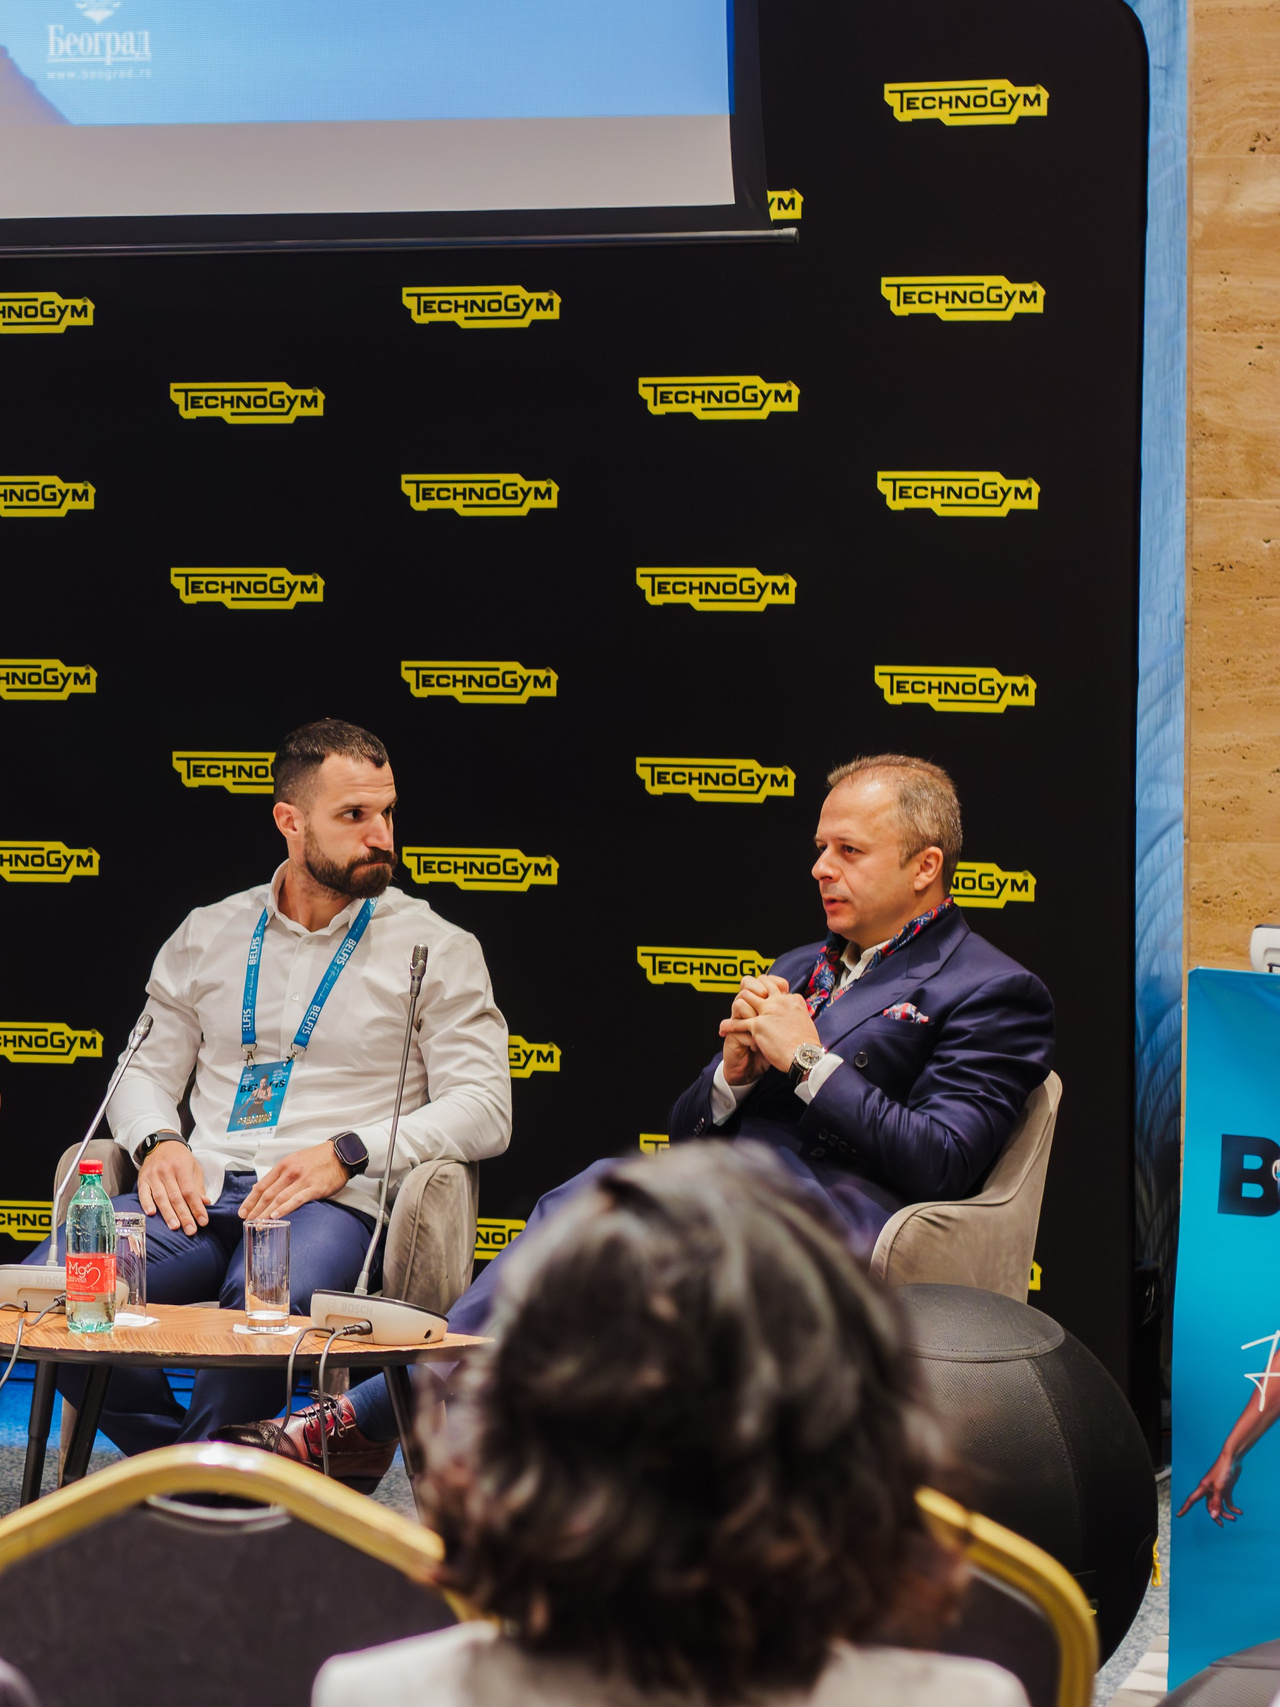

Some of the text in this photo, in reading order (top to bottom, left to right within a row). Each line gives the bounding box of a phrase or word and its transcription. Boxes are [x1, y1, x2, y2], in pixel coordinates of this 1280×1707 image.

[46, 24, 151, 65] Београд
[176, 757, 274, 786] TECHNO
[248, 936, 261, 966] BELFIS
[336, 937, 358, 966] BELFIS
[641, 952, 770, 984] TECHNOGY
[301, 1004, 322, 1036] BELFIS
[36, 1275, 66, 1287] BOSC
[341, 1302, 373, 1316] BOSCH
